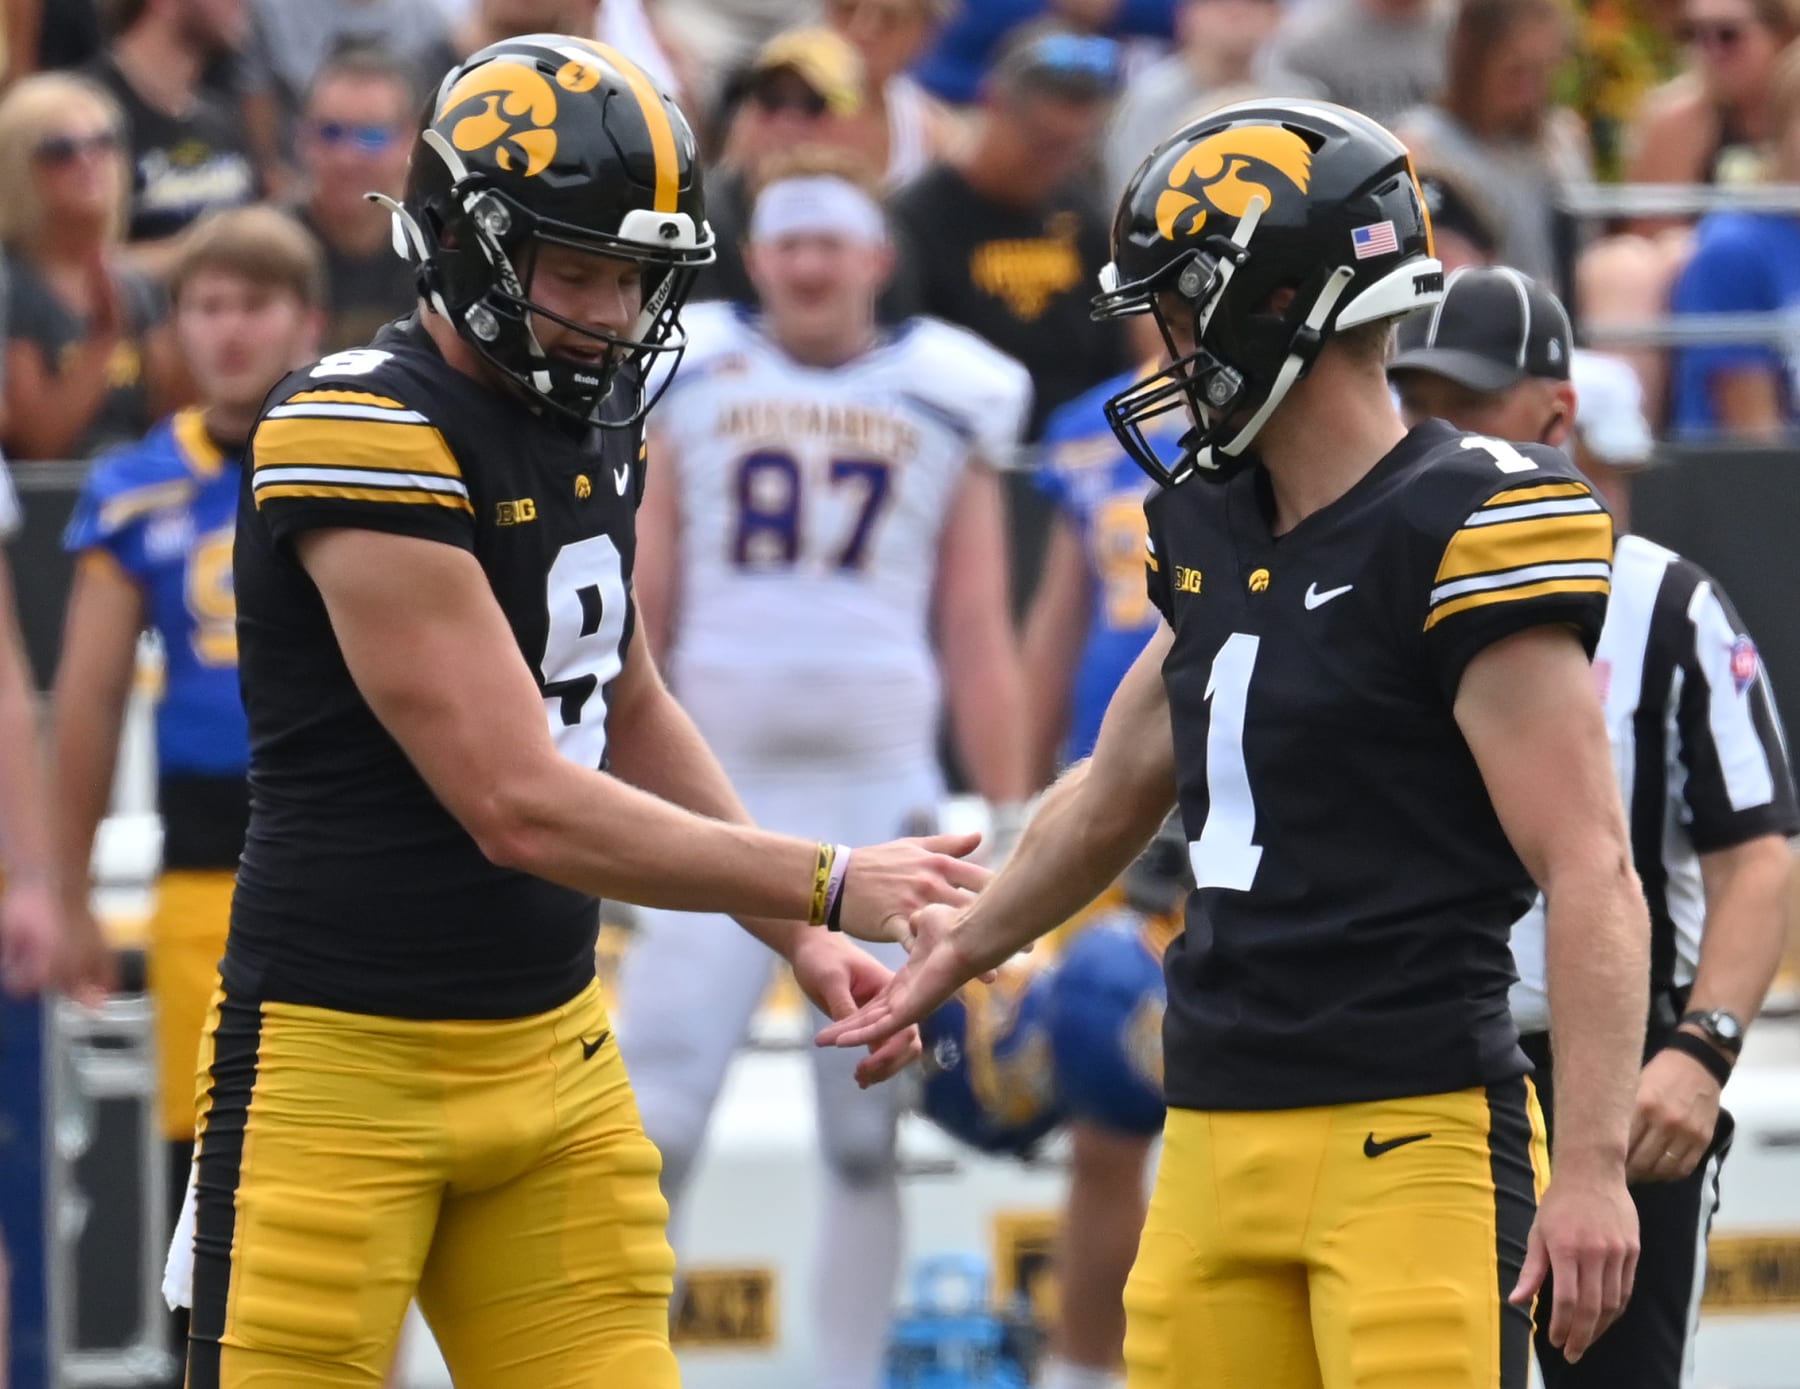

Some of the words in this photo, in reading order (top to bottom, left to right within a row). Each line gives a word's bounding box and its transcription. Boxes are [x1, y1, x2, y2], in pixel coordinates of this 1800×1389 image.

[734, 448, 891, 571] 87
[1460, 436, 1539, 474] 1
[540, 533, 626, 771] 9
[1188, 632, 1263, 891] 1
